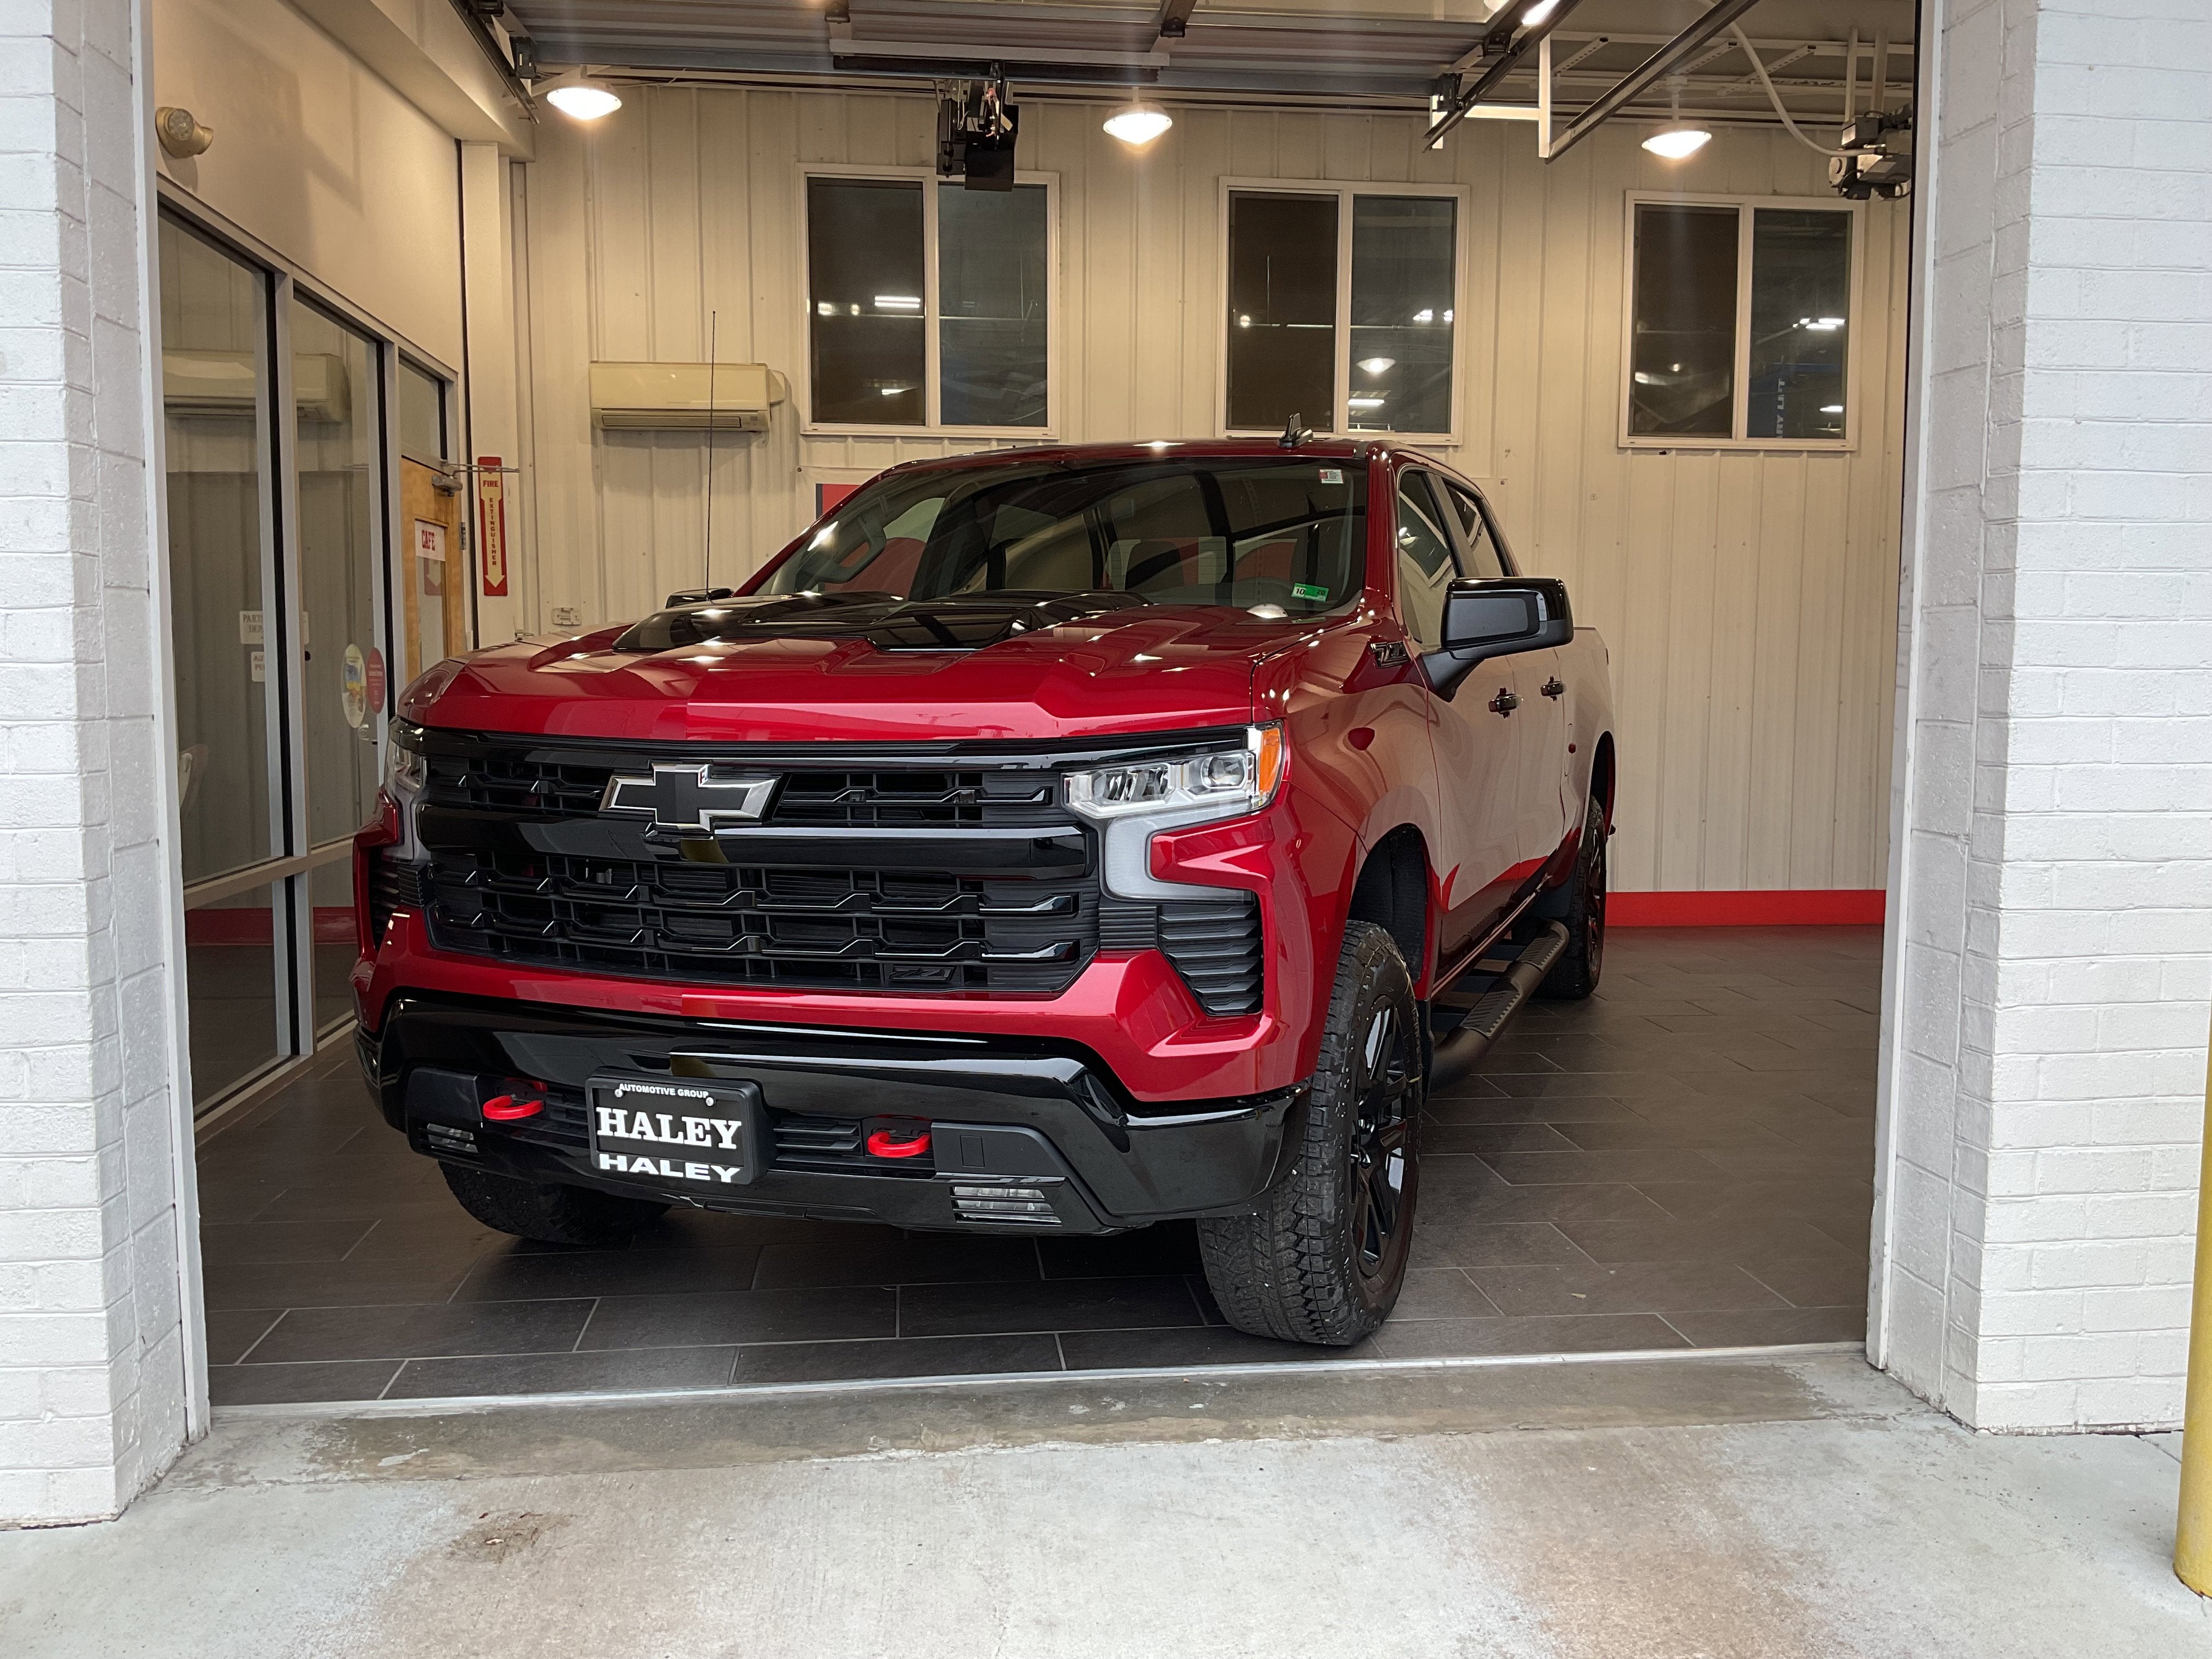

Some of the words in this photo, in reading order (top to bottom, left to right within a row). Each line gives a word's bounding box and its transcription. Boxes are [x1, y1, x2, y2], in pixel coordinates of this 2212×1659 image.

[422, 530, 435, 550] CAFE
[618, 1083, 676, 1096] AUTOMOTIVE
[677, 1088, 709, 1098] GROUP
[596, 1106, 742, 1149] HALEY
[599, 1153, 741, 1183] HALEY
